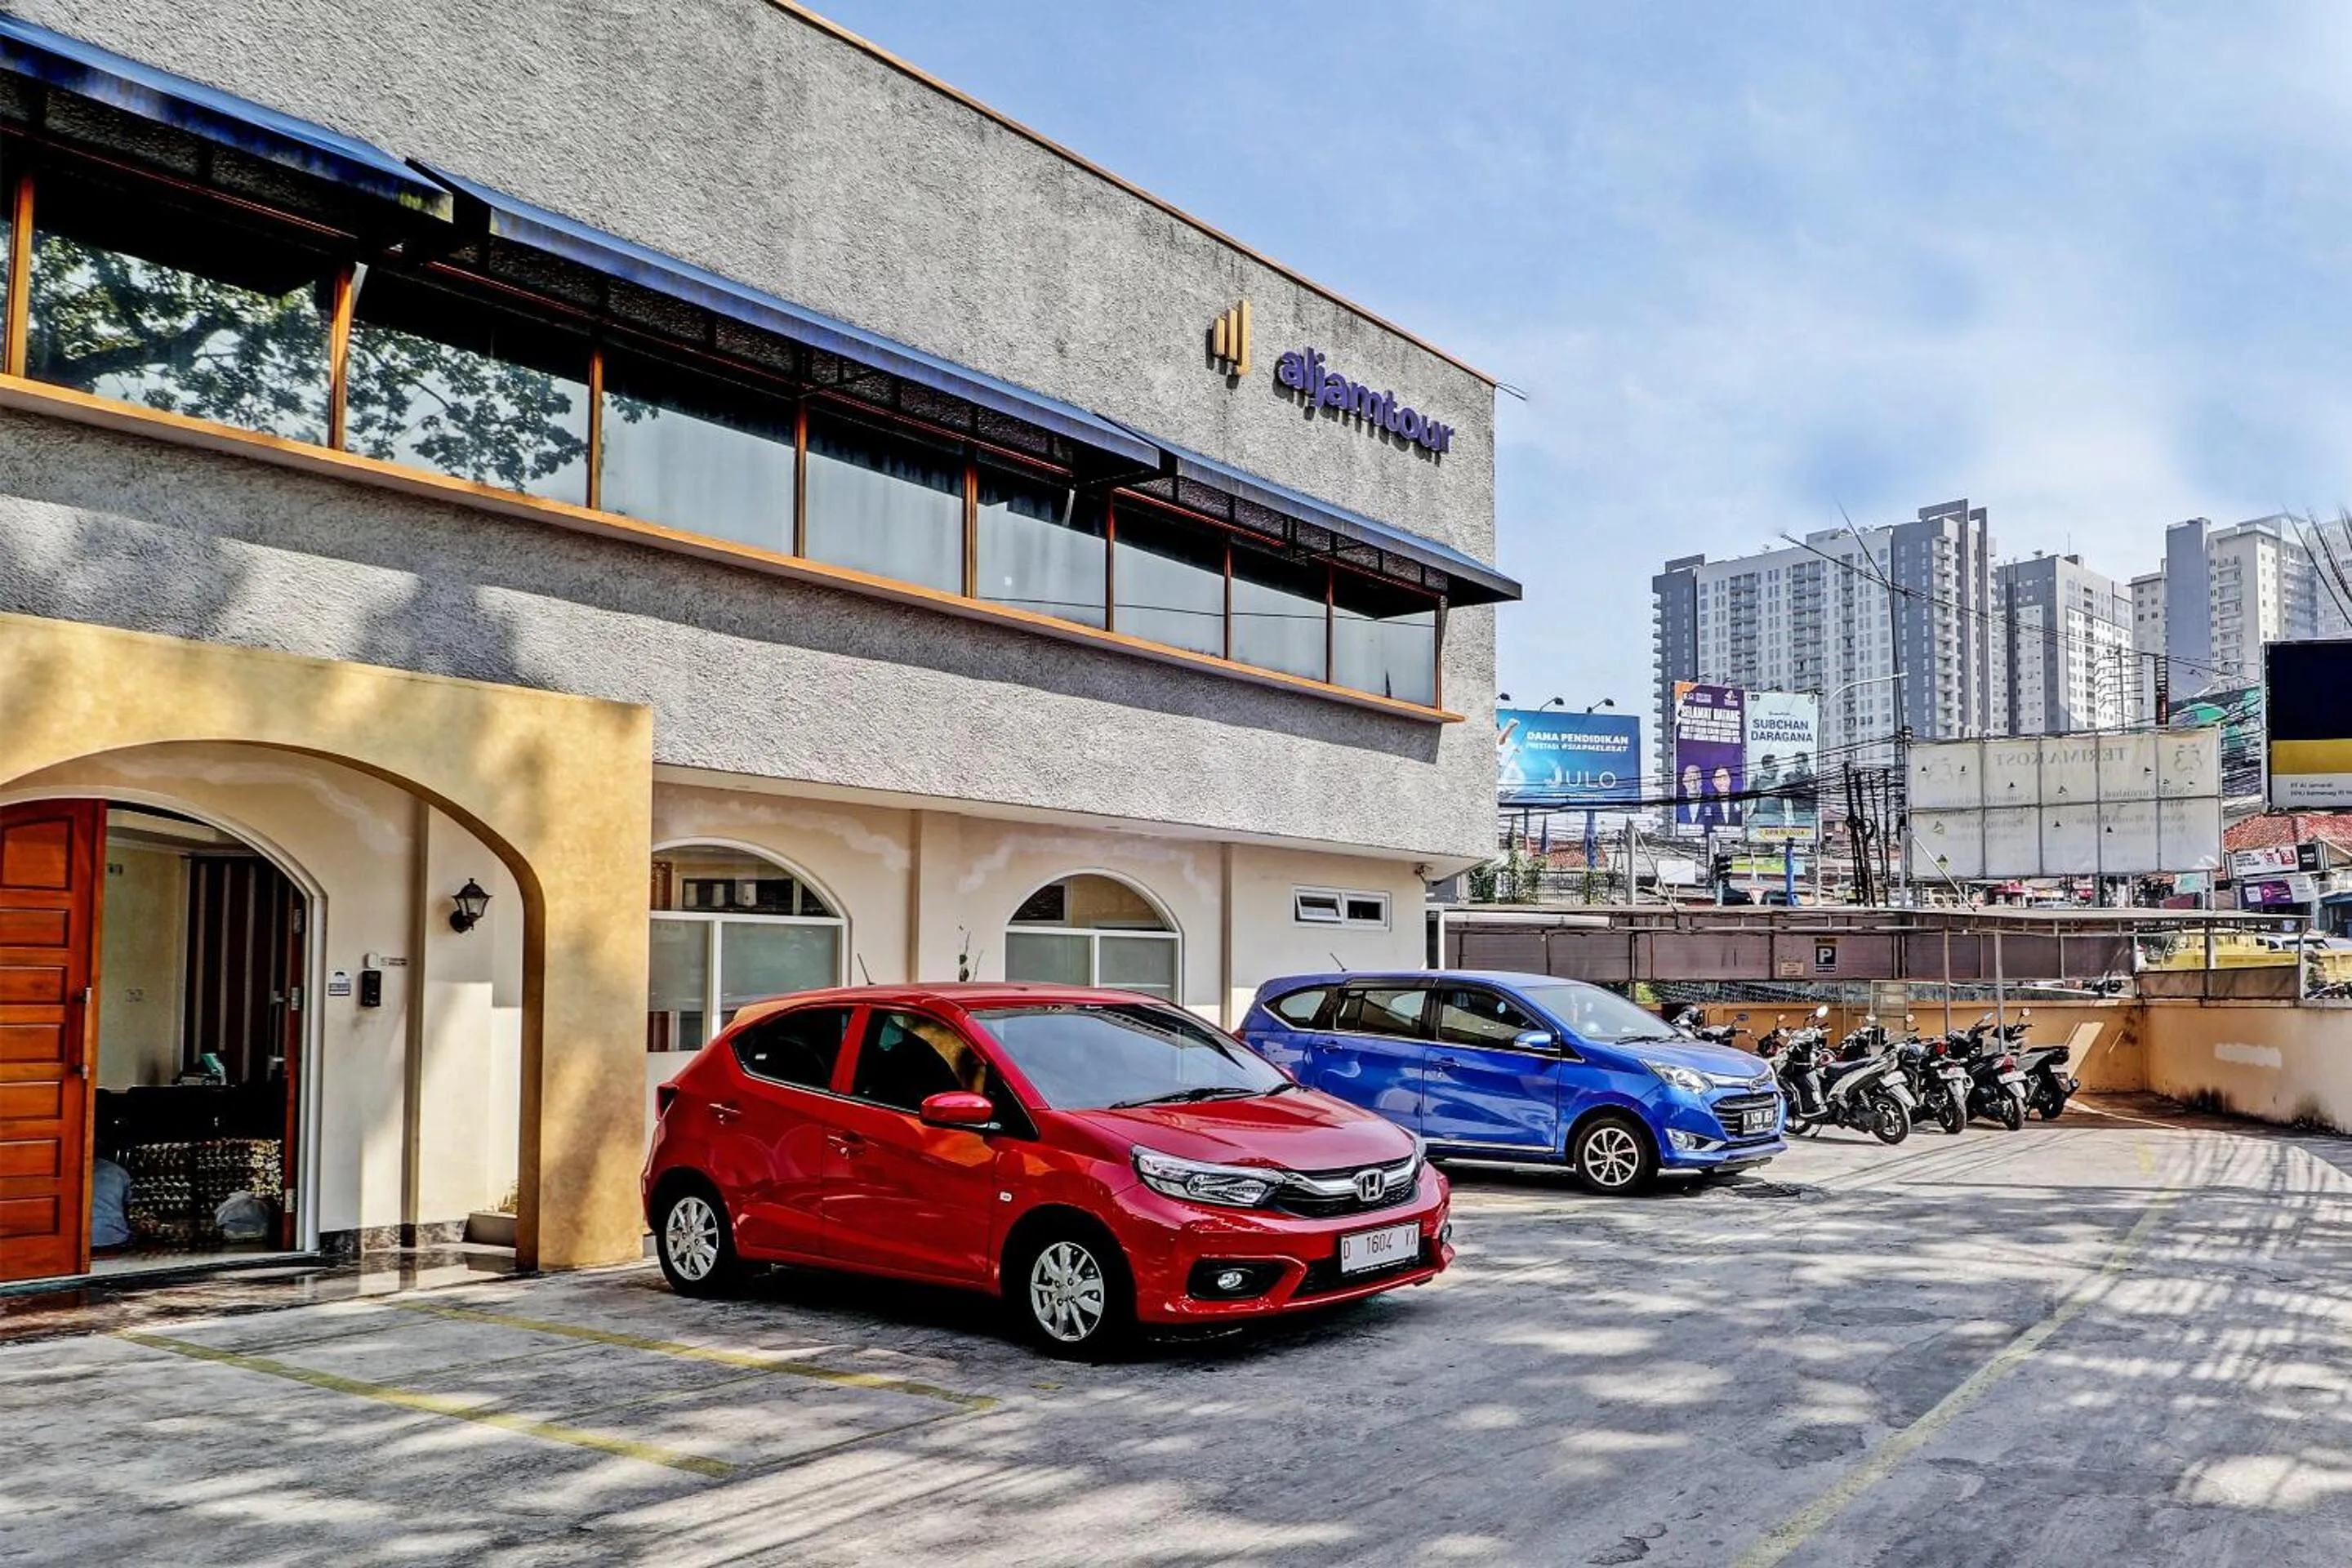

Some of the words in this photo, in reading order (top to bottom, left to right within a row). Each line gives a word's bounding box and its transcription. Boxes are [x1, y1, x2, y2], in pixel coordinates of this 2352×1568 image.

[1279, 346, 1454, 454] aljamtour
[1753, 719, 1809, 729] SUBCHAN
[1526, 731, 1559, 742] DANA
[1561, 733, 1628, 745] PENDIDIKAN
[1751, 731, 1813, 743] DARAGANA
[1545, 759, 1616, 788] JULO
[1819, 948, 1833, 964] P
[1343, 1241, 1351, 1259] D
[1366, 1232, 1393, 1254] 1604
